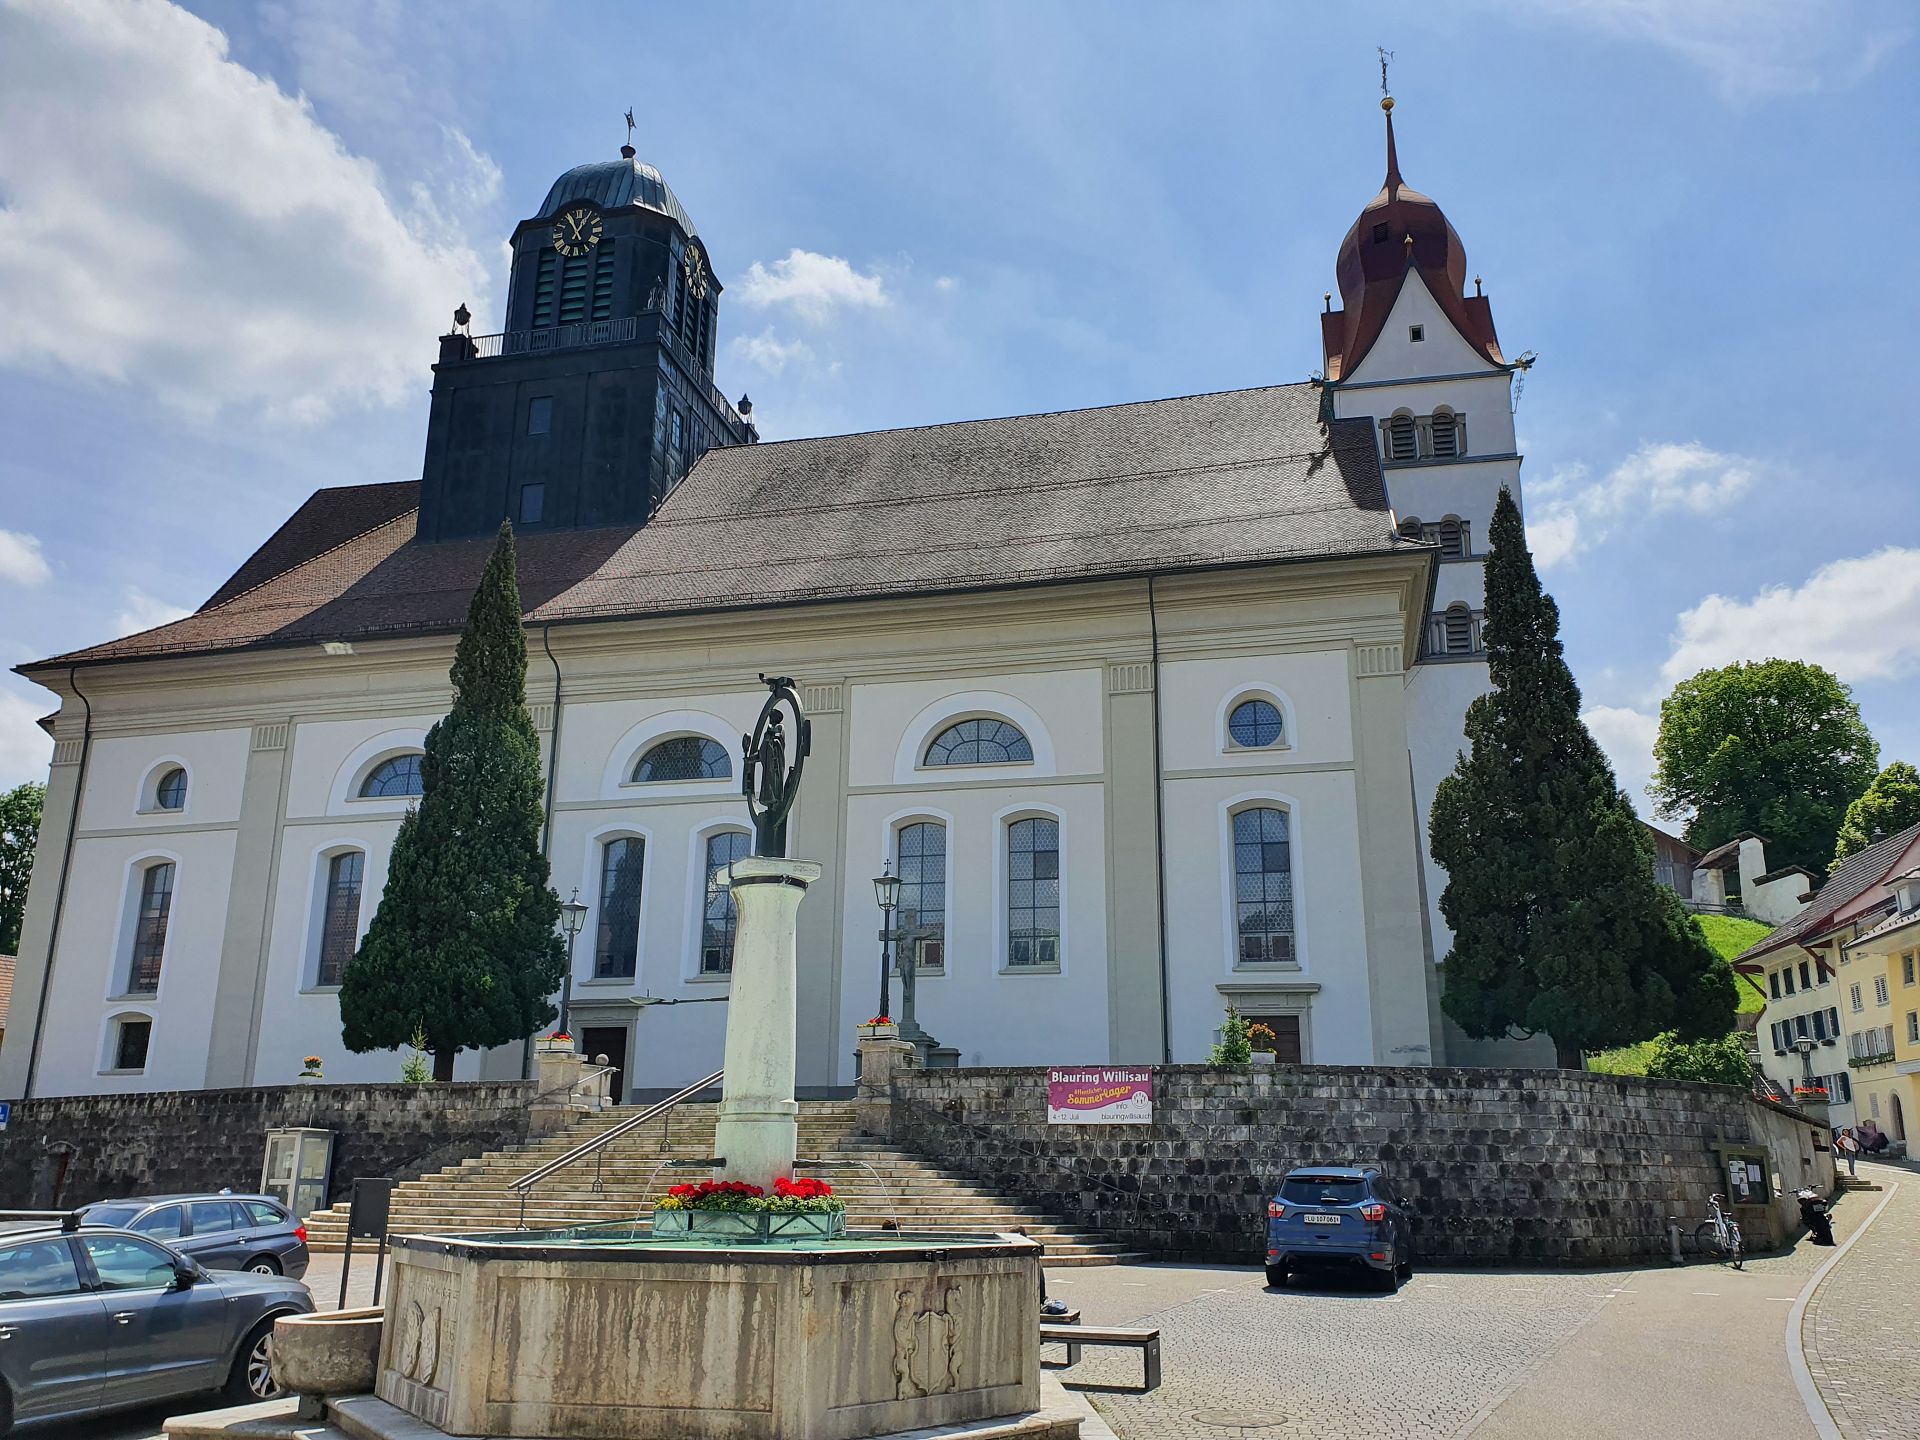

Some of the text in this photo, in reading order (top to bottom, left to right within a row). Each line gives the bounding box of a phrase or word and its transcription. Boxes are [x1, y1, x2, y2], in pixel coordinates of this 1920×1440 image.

[1051, 1071, 1149, 1085] Blauring Willisau
[1067, 1085, 1131, 1105] Sommerlager
